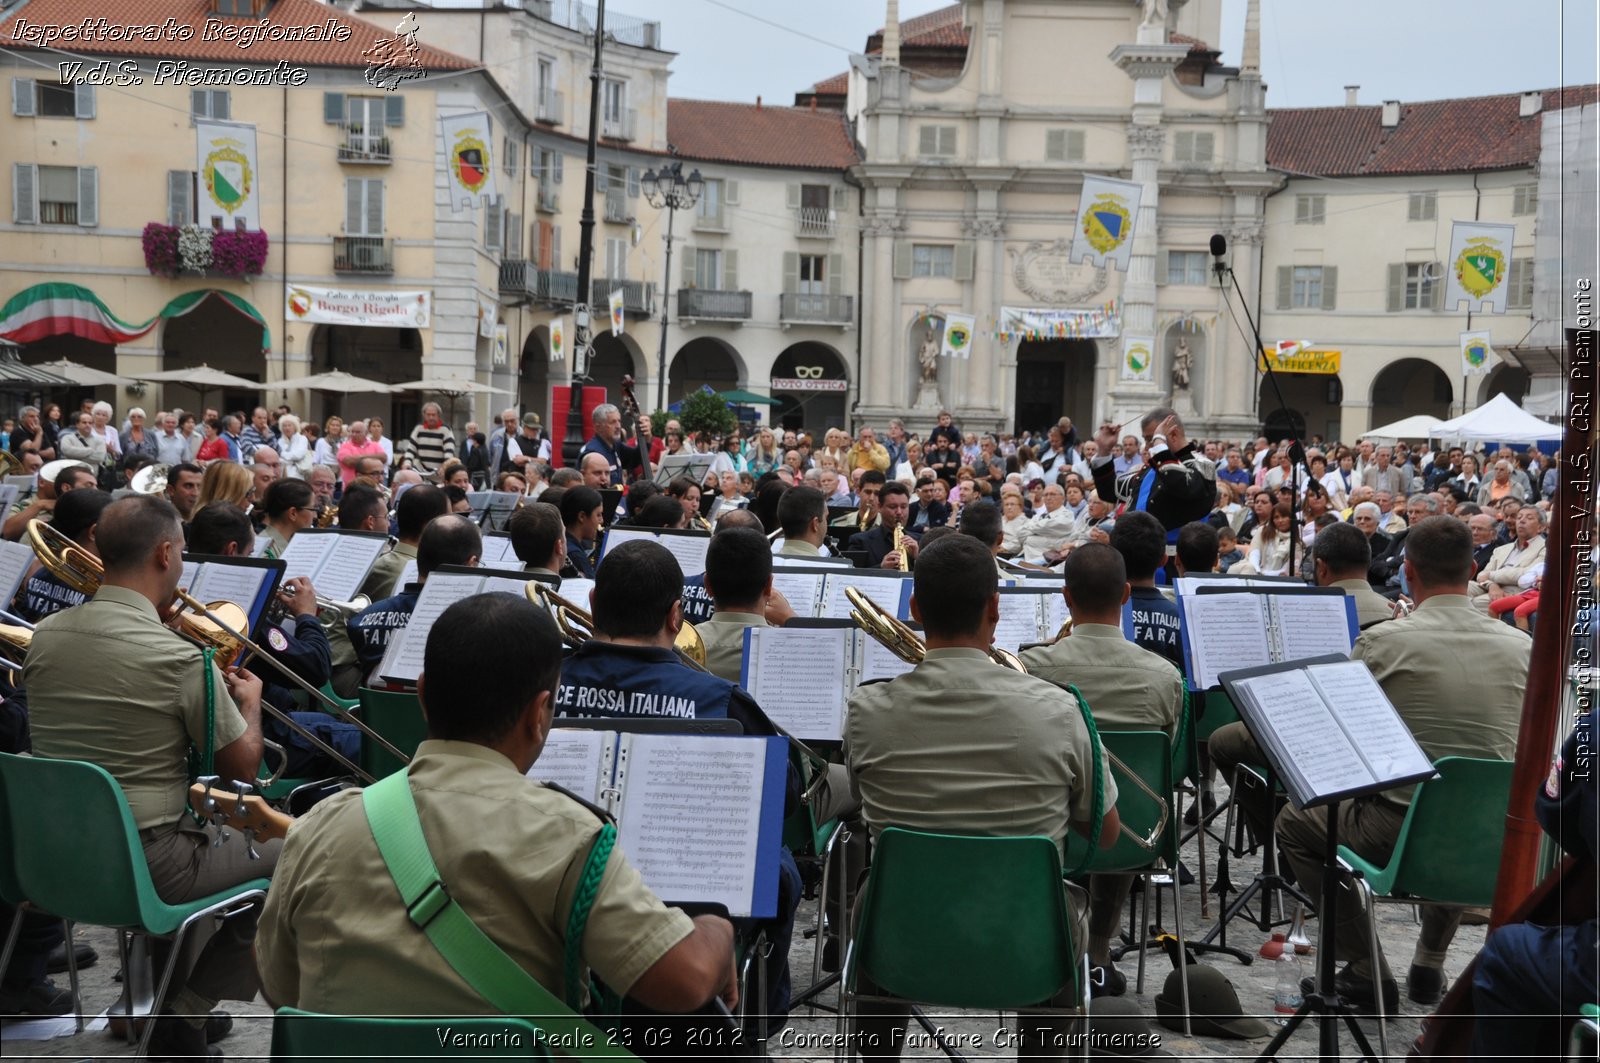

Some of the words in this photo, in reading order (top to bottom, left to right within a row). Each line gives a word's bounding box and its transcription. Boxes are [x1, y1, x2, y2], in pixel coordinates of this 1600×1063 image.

[317, 300, 359, 314] Borgo
[363, 303, 408, 316] Rigola
[1263, 358, 1336, 370] BENEFICENZA
[774, 380, 803, 389] FOTO
[805, 380, 845, 390] OTTICA
[51, 584, 86, 606] ITALIANA
[1134, 626, 1176, 645] FARA
[576, 687, 625, 713] ROSSA
[629, 692, 696, 719] ITALIANA
